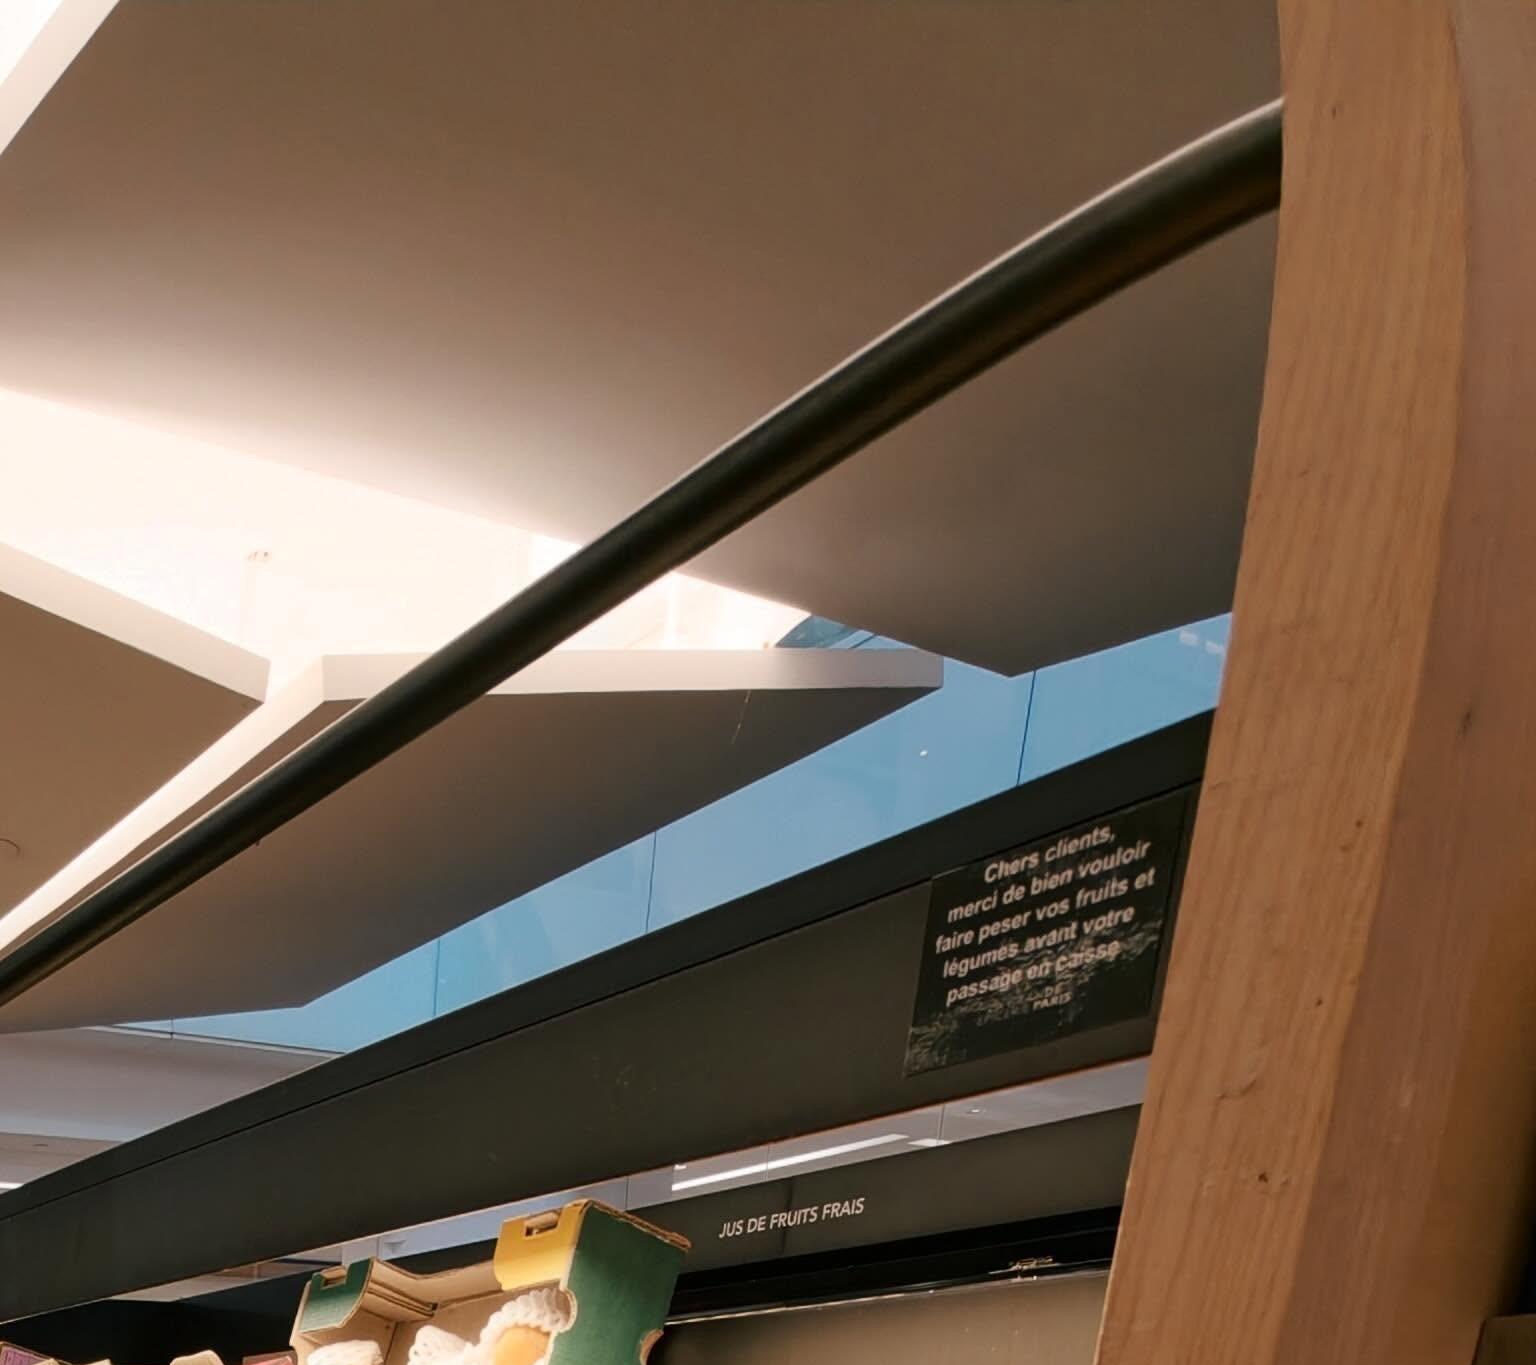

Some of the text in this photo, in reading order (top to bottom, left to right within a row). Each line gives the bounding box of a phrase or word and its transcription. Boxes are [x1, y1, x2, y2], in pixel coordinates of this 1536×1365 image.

[947, 841, 1151, 923] merci de bien vouloir
[984, 824, 1115, 883] Chers clients,
[935, 868, 1155, 954] faire peser vos fruits et
[942, 906, 1135, 979] légumes avant votre
[945, 965, 1023, 1008] passage
[1027, 960, 1053, 980] en
[718, 1197, 865, 1239] JUS DE FRUITS FRAIS
